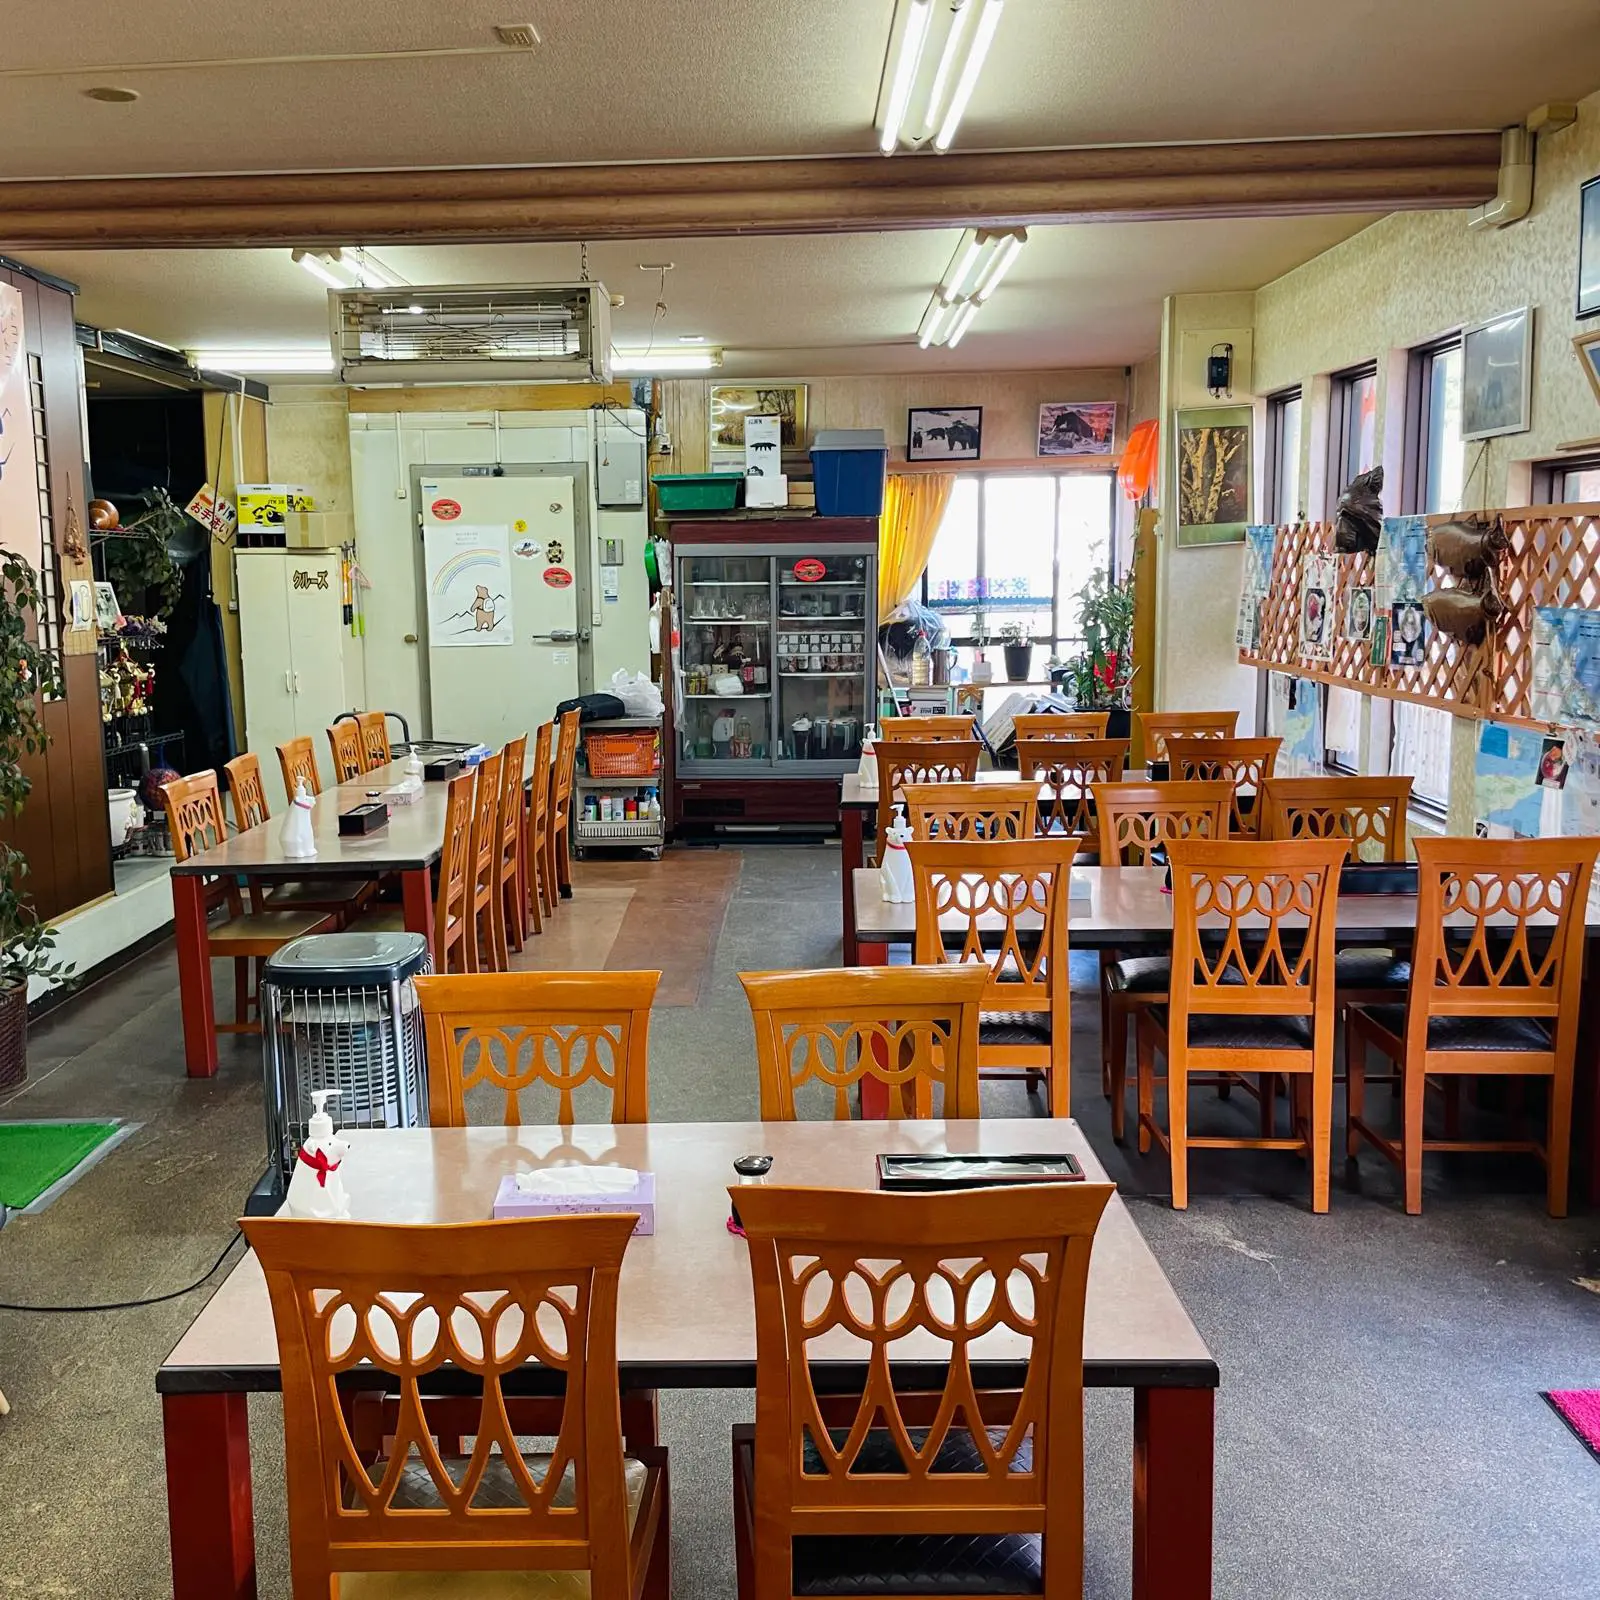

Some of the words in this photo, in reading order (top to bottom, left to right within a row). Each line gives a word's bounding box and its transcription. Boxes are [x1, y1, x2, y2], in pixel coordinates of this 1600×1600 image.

[190, 502, 229, 535] お手洗い
[293, 570, 329, 590] クルーズ
